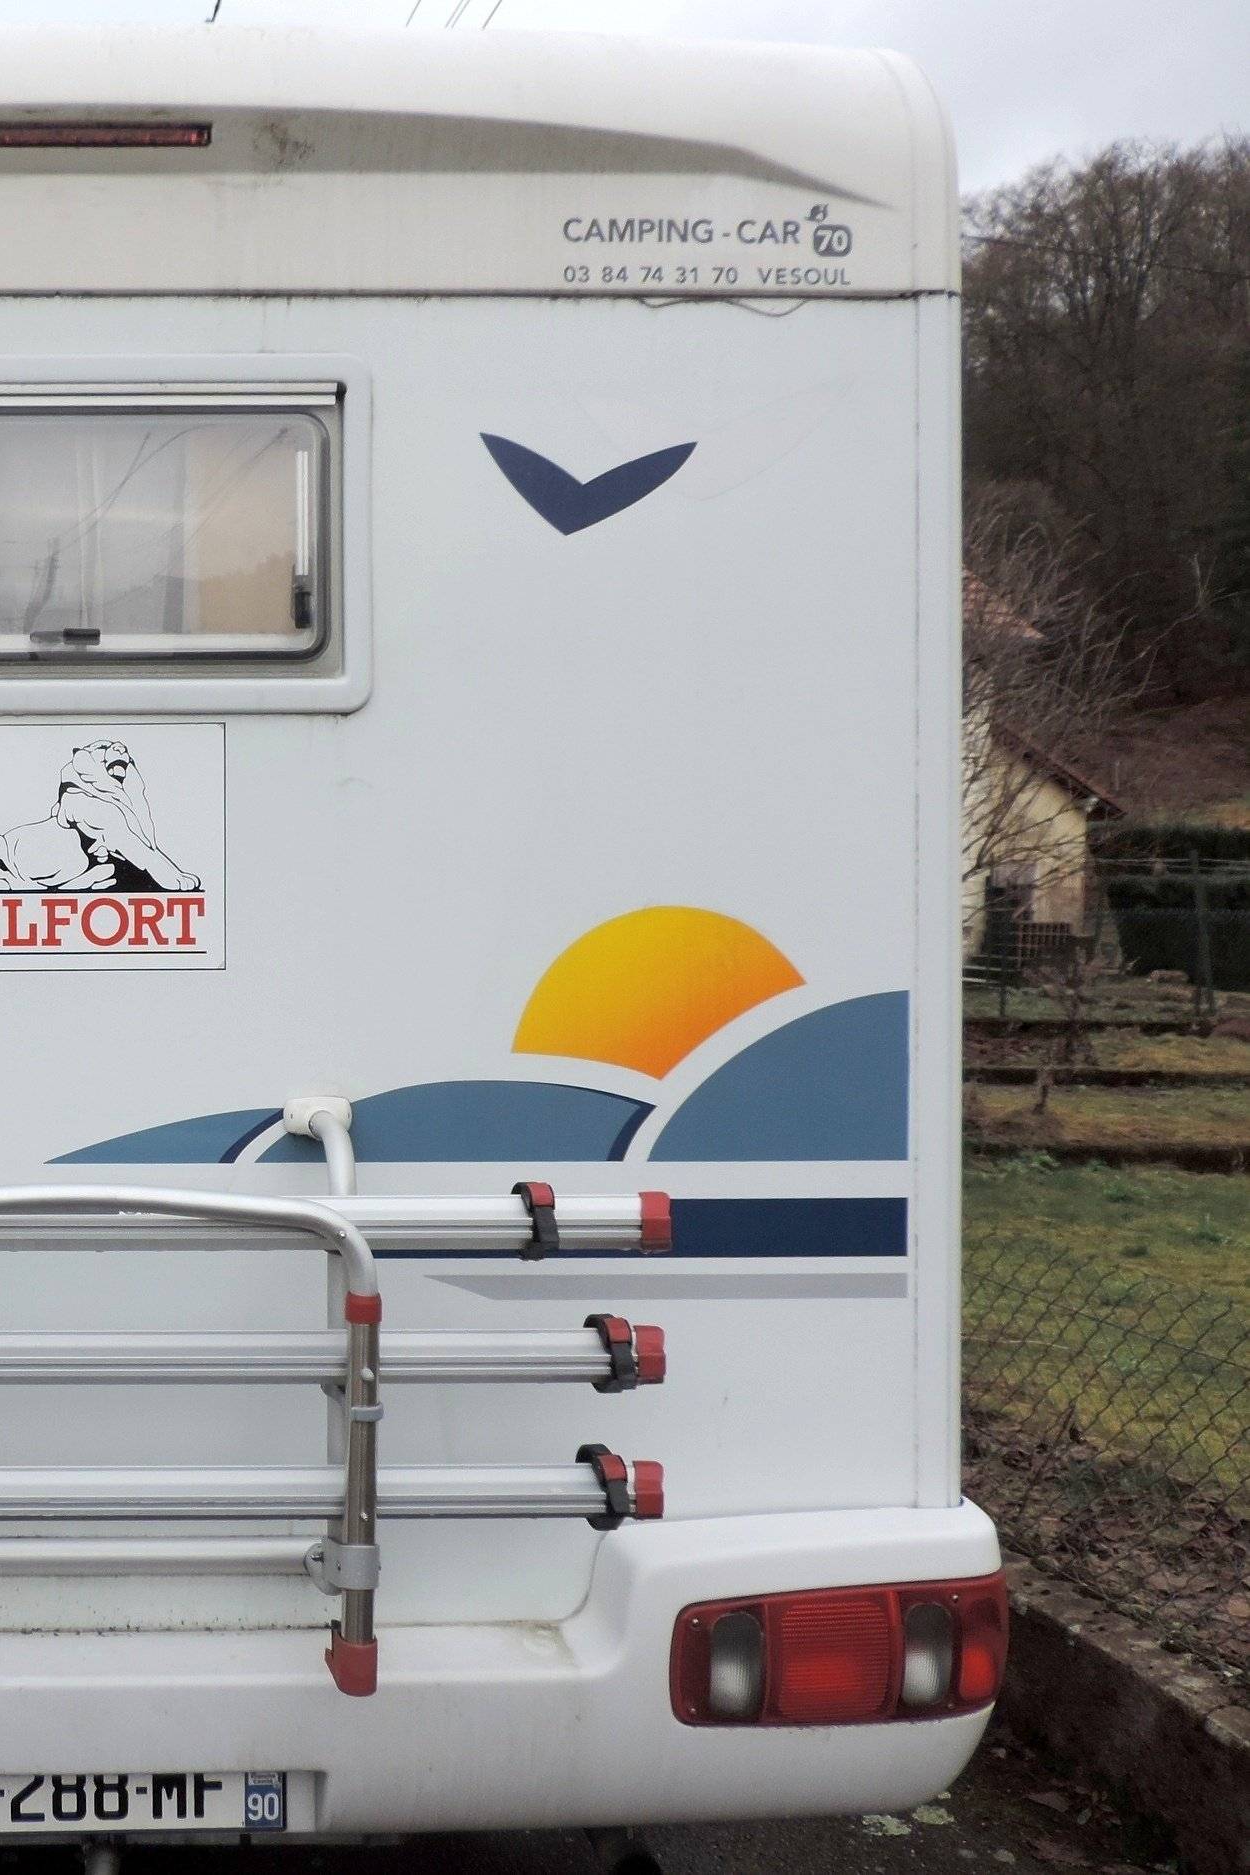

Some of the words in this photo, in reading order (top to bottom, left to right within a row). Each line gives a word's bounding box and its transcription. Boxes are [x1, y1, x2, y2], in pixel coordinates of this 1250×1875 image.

[816, 229, 849, 253] 70
[563, 265, 590, 283] 03
[601, 265, 628, 283] 84
[640, 265, 664, 284] 74
[676, 266, 698, 284] 31
[712, 266, 738, 284] 70
[757, 267, 850, 285] VESOUL
[247, 1793, 279, 1820] 90
